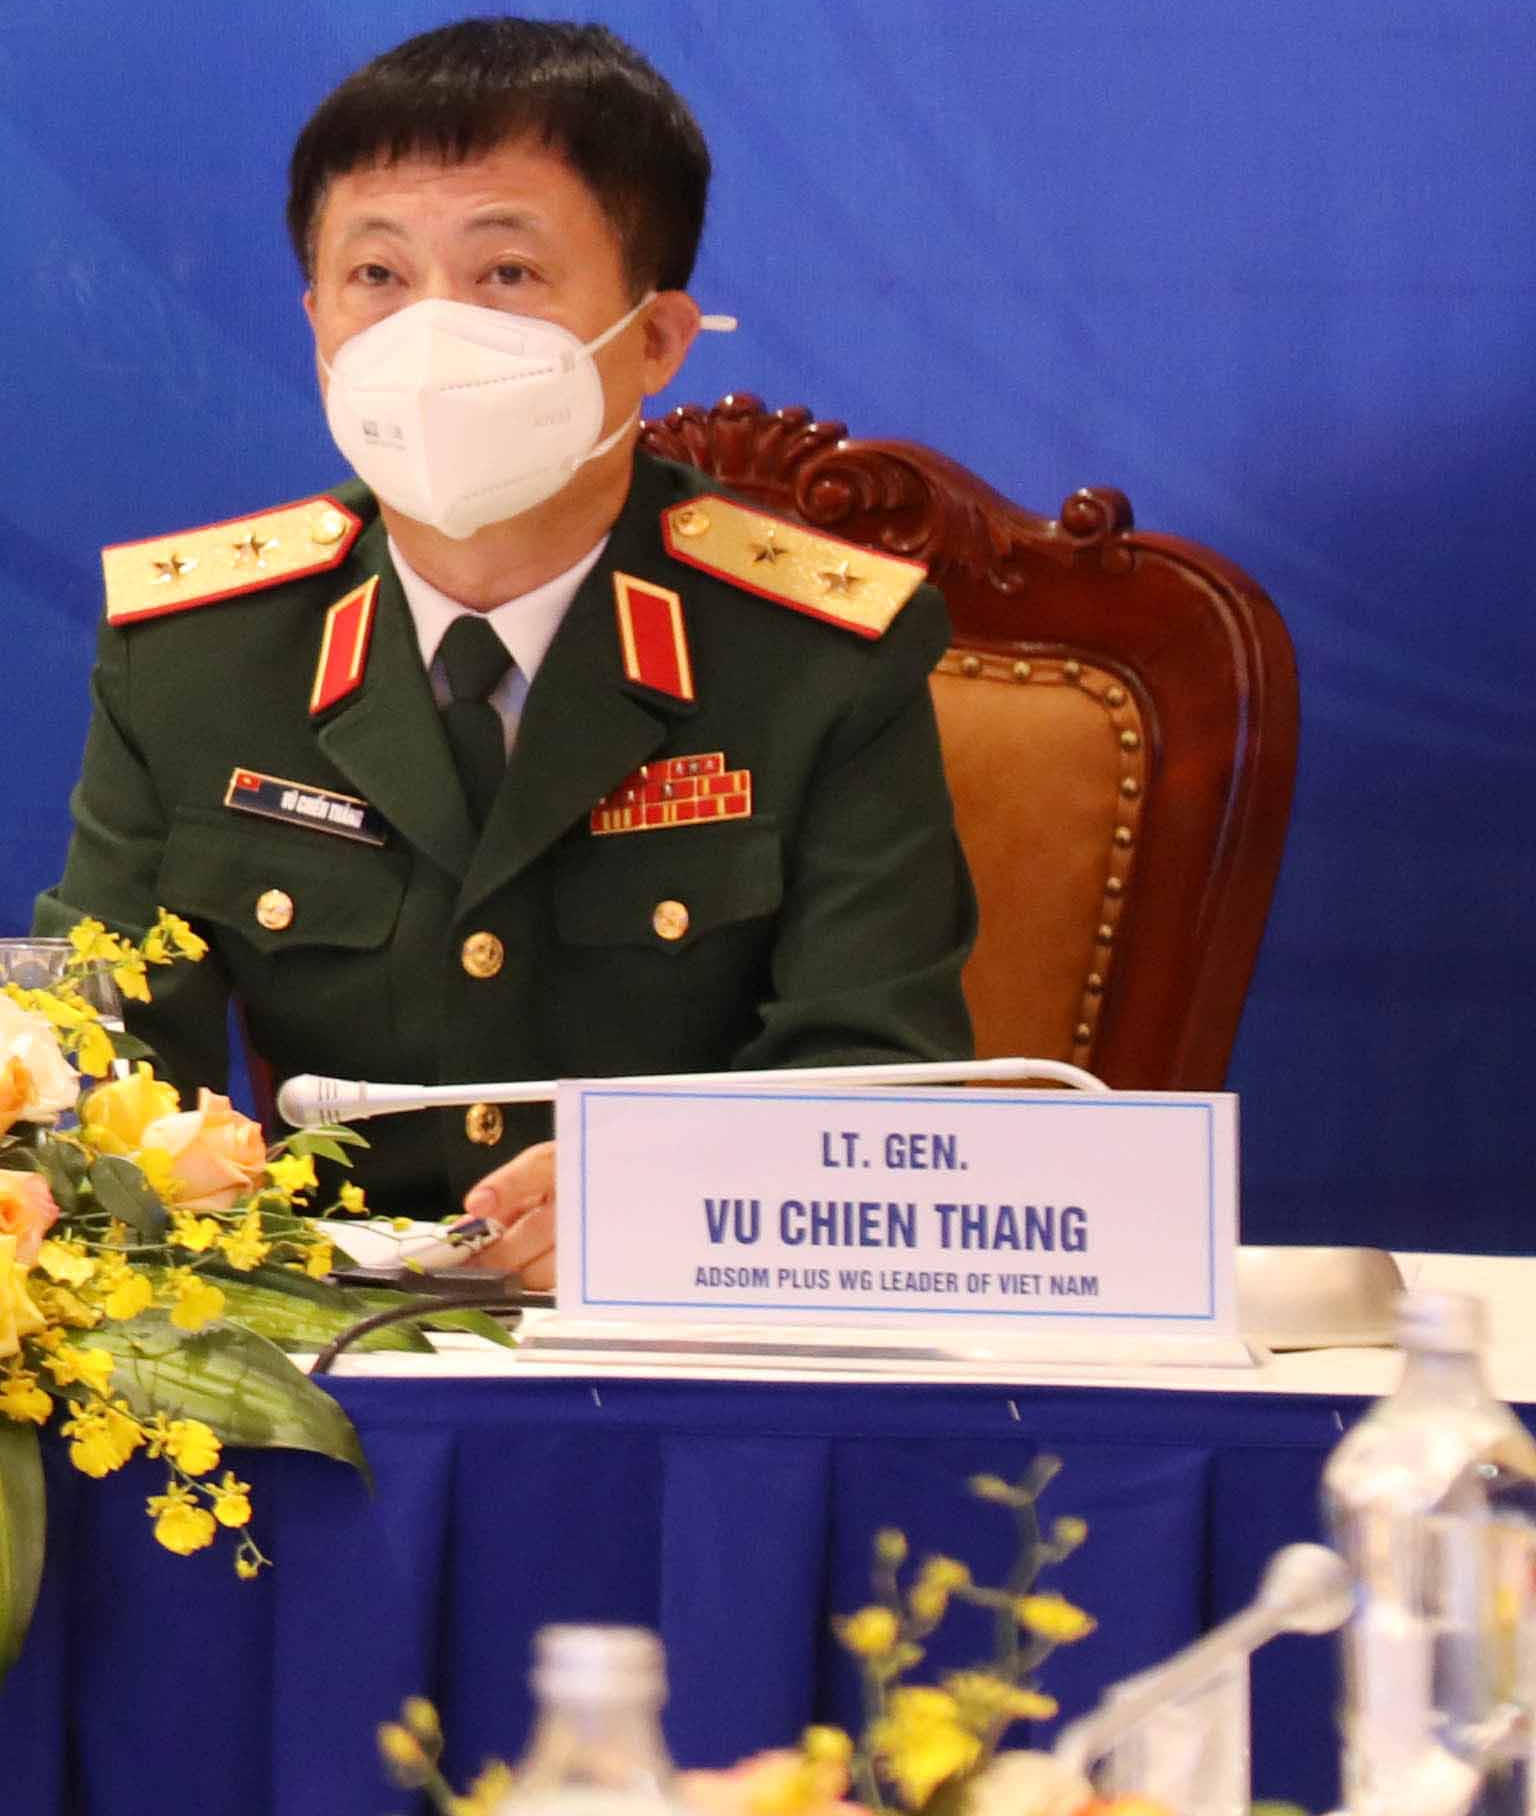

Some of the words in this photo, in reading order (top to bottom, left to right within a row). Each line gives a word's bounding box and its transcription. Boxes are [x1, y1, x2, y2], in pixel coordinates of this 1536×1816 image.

[822, 1131, 872, 1169] LT.
[884, 1132, 969, 1172] GEN.
[703, 1198, 760, 1246] VU
[779, 1199, 917, 1249] CHIEN
[933, 1202, 1088, 1253] THANG
[694, 1265, 770, 1289] ADSOM
[777, 1268, 830, 1290] PLUS
[838, 1269, 873, 1291] WG
[880, 1270, 959, 1294] LEADER
[966, 1272, 992, 1295] OF
[999, 1273, 1042, 1296] VIET
[1049, 1274, 1099, 1297] NAM
